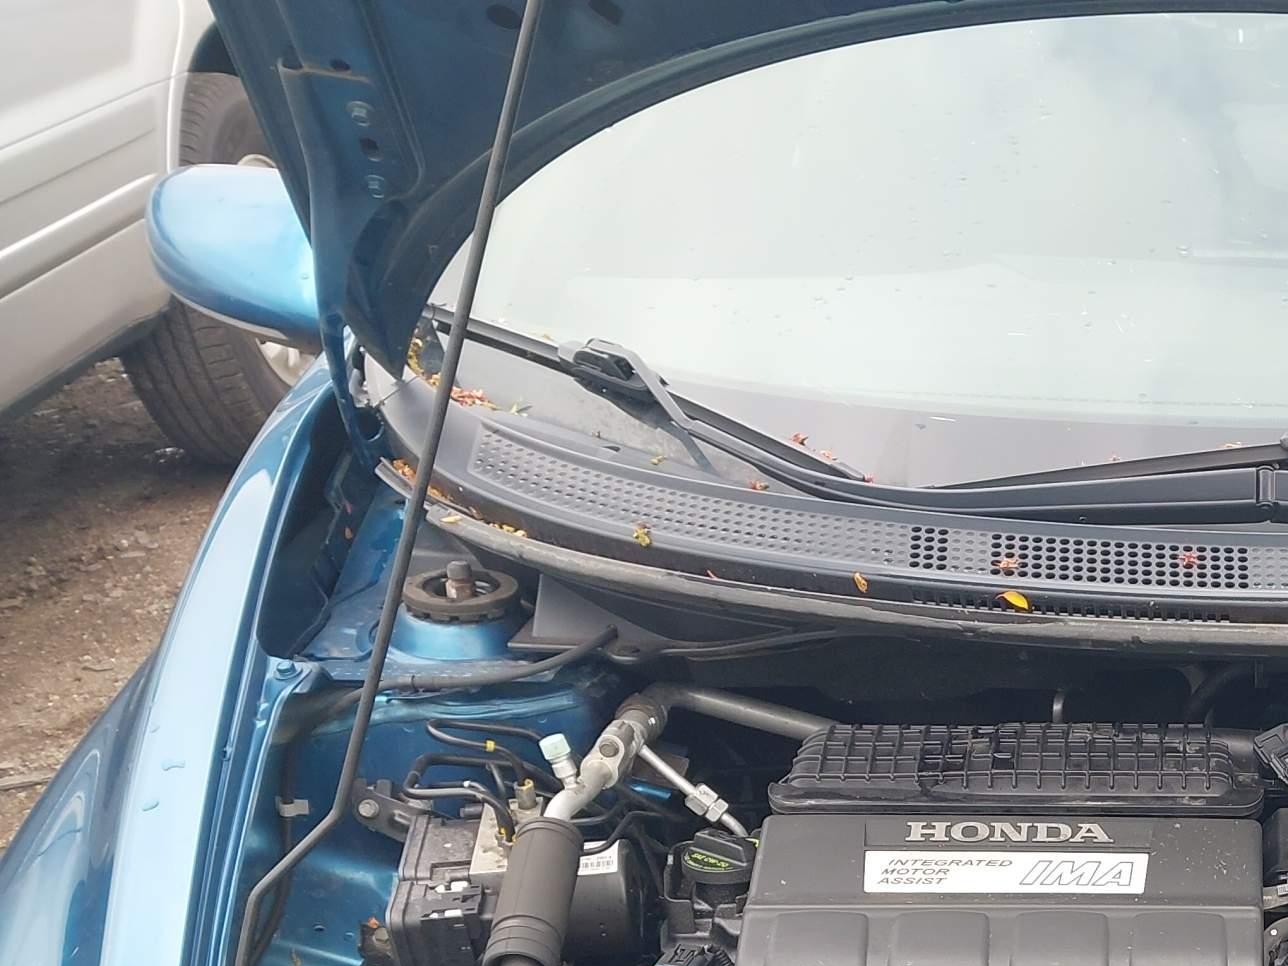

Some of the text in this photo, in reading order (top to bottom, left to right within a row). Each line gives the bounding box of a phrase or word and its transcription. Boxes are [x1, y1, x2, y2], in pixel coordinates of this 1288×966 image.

[904, 821, 1114, 843] HONDA
[888, 858, 1013, 868] INTEGRATED
[880, 868, 950, 876] MOTOR
[1019, 860, 1135, 887] IMA
[877, 877, 948, 885] ASSIST
